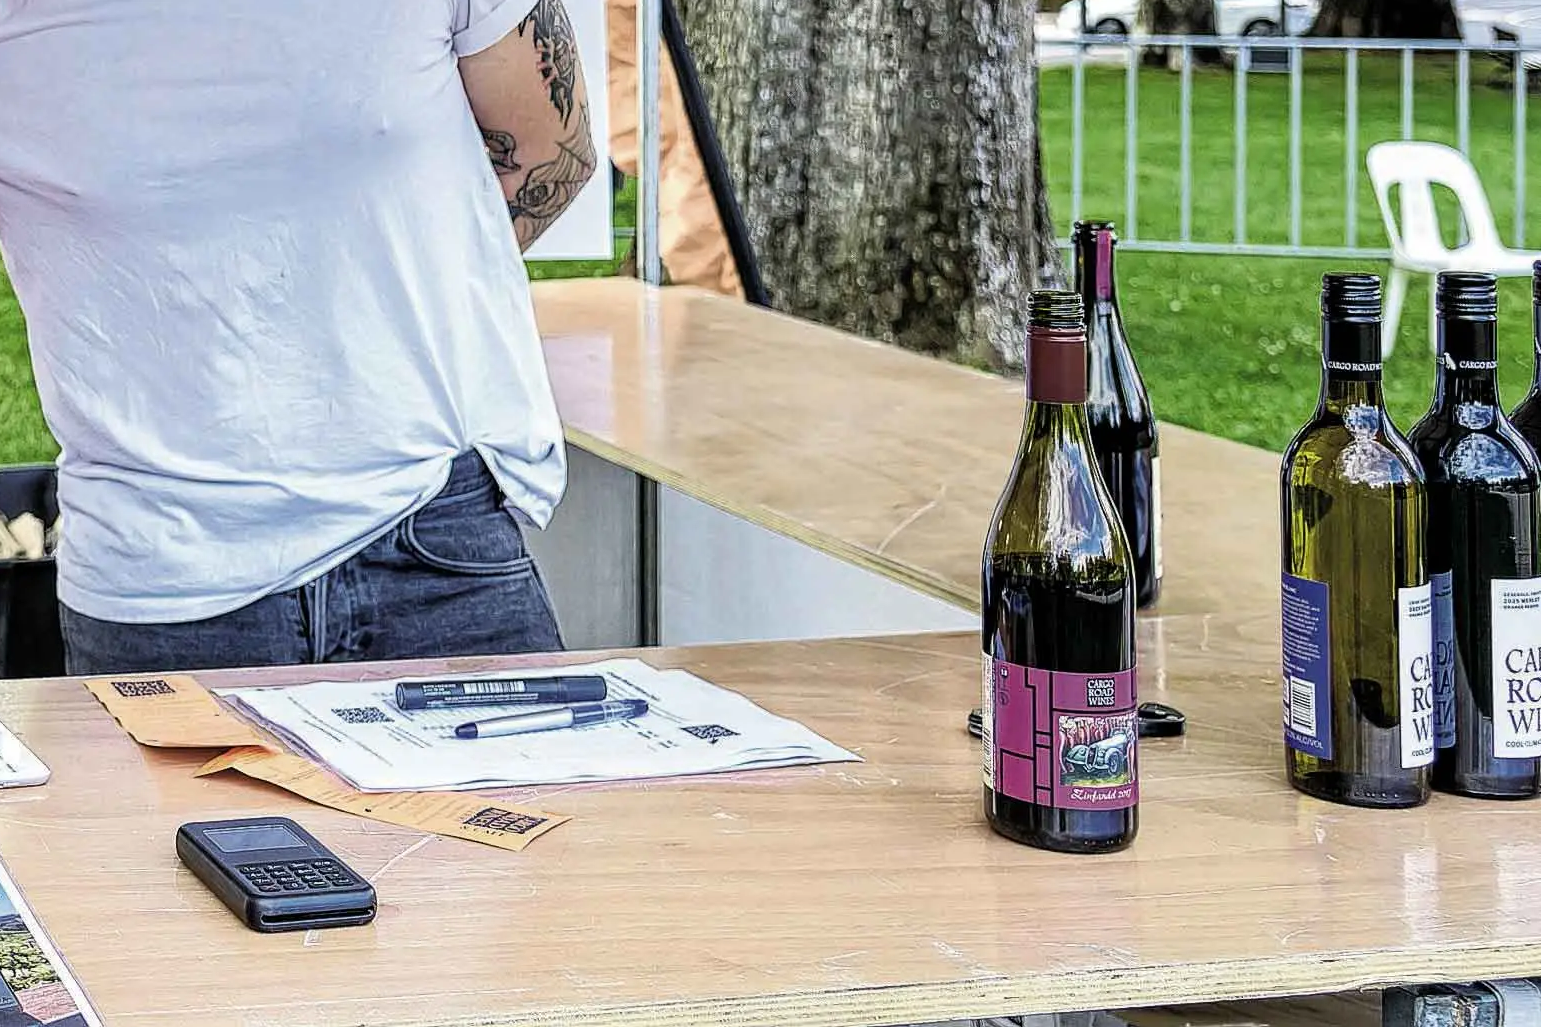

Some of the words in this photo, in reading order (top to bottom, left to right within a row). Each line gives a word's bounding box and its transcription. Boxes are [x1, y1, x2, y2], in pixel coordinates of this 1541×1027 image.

[1327, 361, 1352, 371] CARGO
[1352, 362, 1376, 371] ROAD
[1459, 360, 1486, 369] CARGO
[1087, 679, 1115, 689] CARGO
[1087, 688, 1115, 697] ROAD
[1088, 696, 1115, 707] WINES
[1070, 788, 1116, 804] Zinfandel
